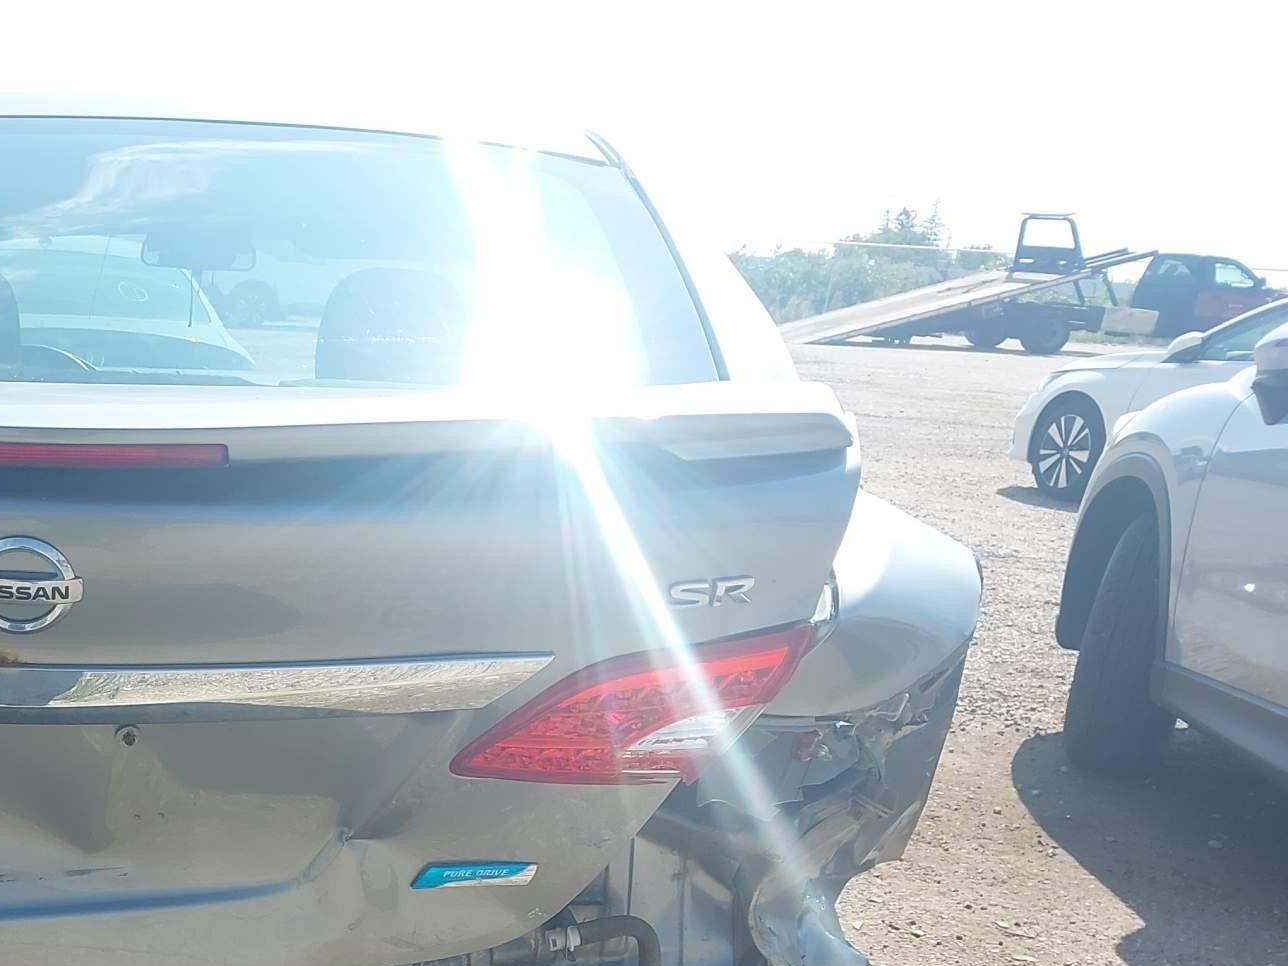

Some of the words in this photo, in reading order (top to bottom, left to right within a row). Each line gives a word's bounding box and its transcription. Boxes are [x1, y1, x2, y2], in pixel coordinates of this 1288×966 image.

[668, 575, 755, 607] SR
[443, 870, 473, 878] PURE
[476, 868, 510, 876] DRIVE
